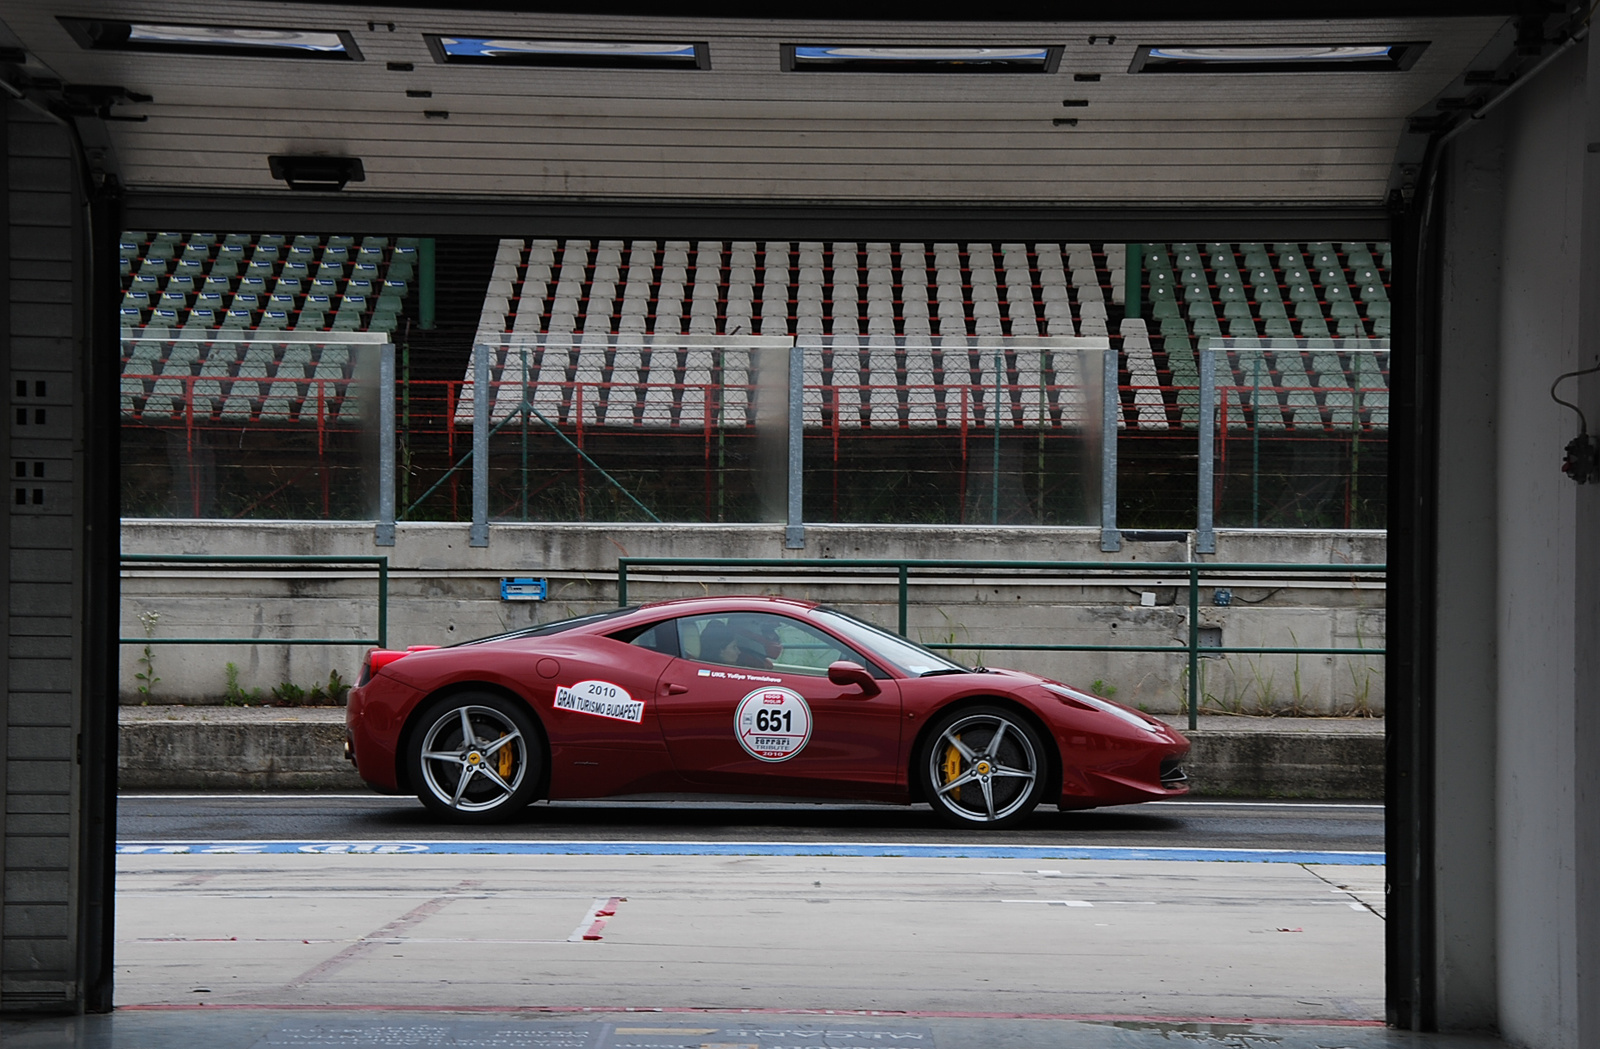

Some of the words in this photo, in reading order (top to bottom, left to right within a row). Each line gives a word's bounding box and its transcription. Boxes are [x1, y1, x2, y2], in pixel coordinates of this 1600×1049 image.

[587, 684, 616, 698] 2010
[557, 688, 577, 709] GRAN
[577, 696, 605, 715] TURISMO
[606, 702, 642, 721] BUDAPEST
[756, 708, 791, 732] 651
[755, 736, 790, 746] Ferrari
